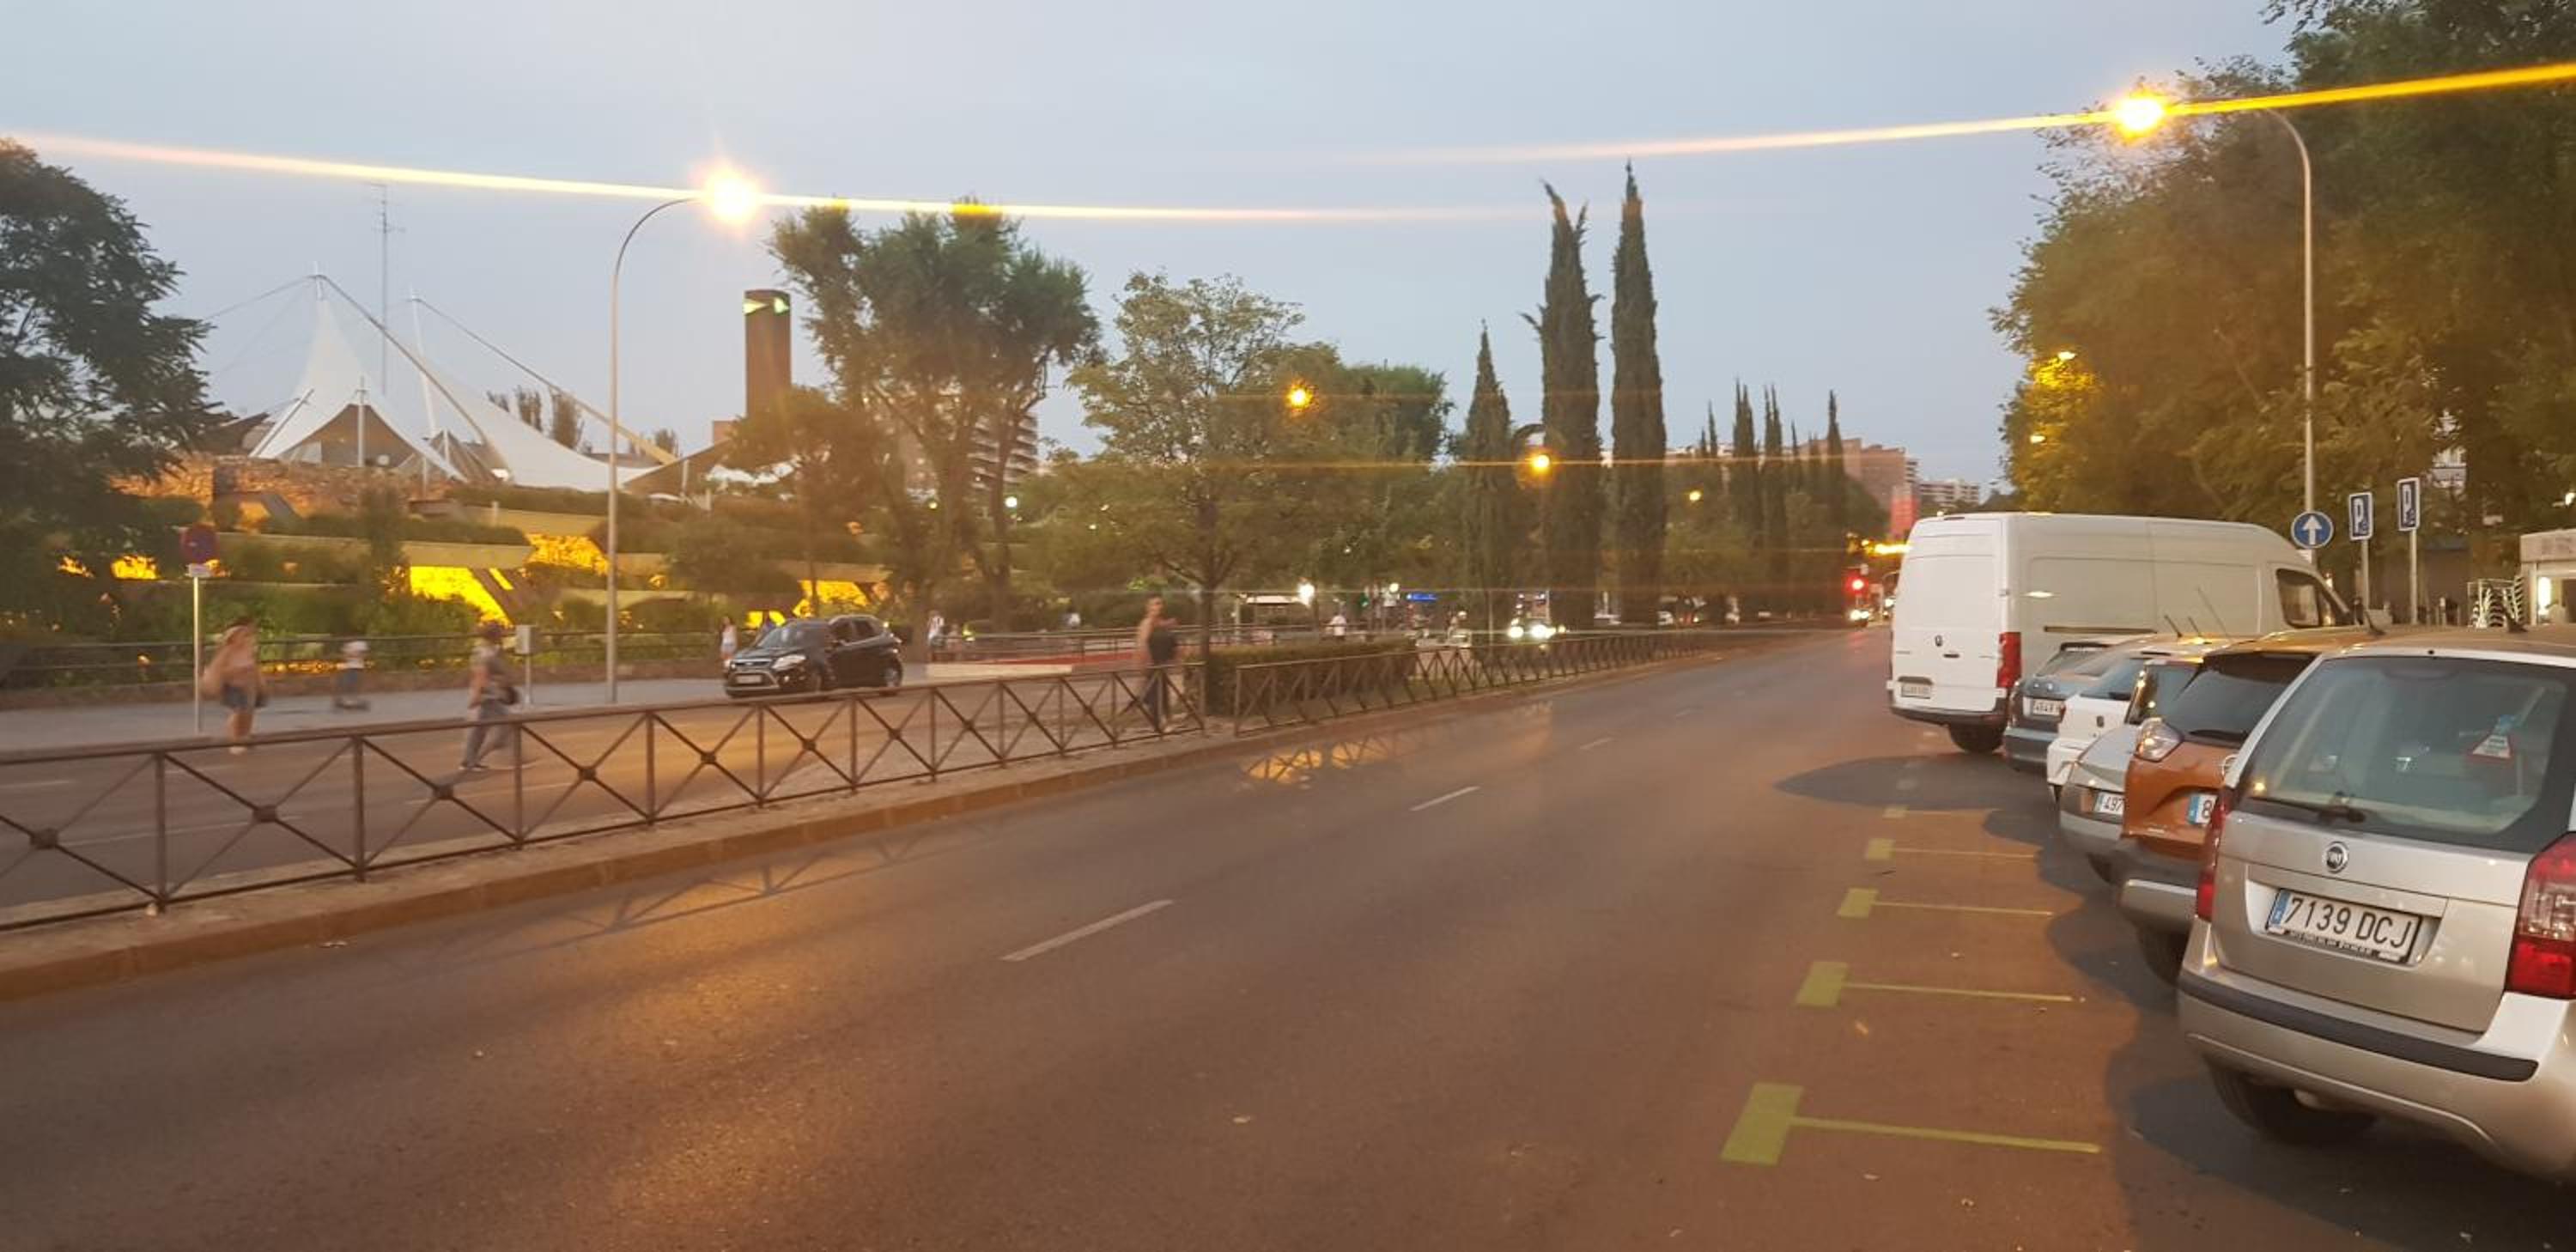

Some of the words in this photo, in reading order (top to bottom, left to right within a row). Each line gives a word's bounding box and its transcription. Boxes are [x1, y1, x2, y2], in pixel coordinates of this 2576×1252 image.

[2354, 498, 2363, 533] P
[2402, 484, 2411, 523] P
[2285, 898, 2351, 934] 7139
[2356, 912, 2411, 947] DCJ
